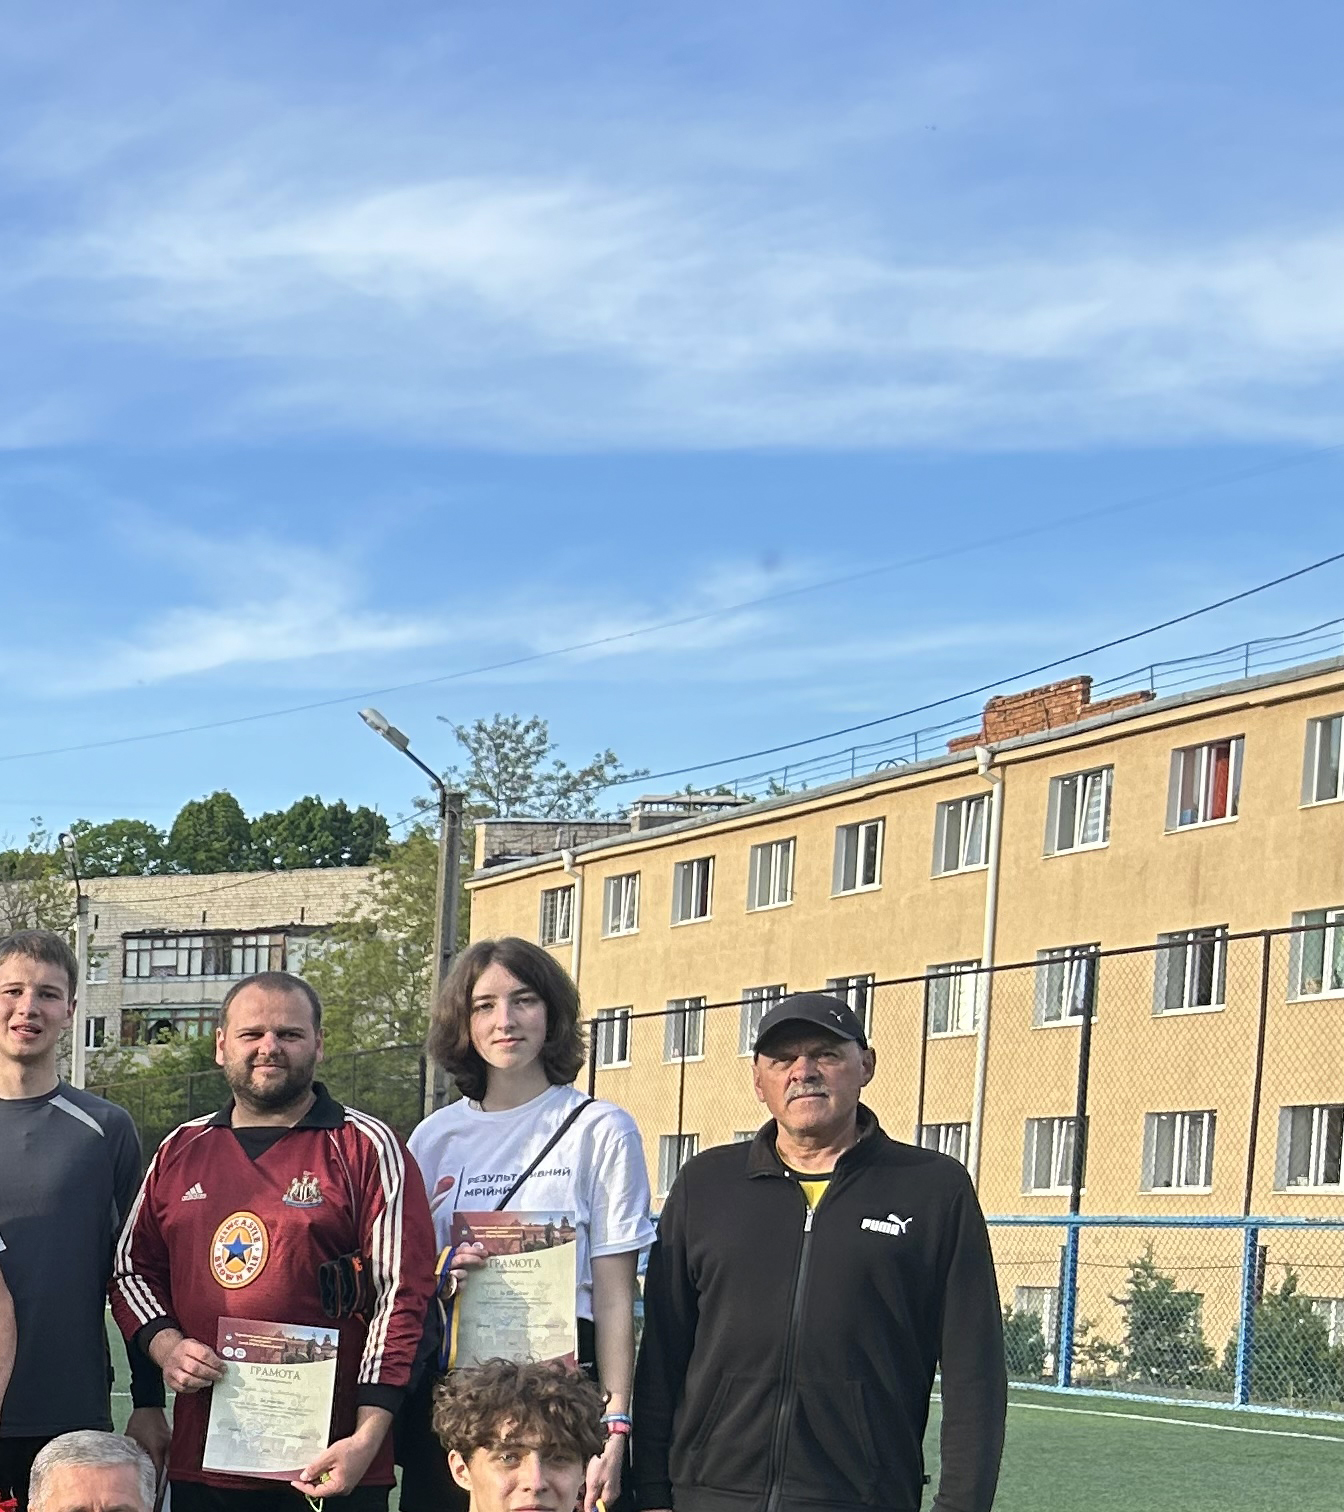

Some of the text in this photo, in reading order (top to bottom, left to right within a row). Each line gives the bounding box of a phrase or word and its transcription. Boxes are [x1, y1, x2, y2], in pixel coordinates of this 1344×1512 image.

[218, 1219, 261, 1243] NEWCASTLE
[214, 1255, 244, 1281] BROWN
[489, 1259, 541, 1268] ГРАМОТА
[250, 1366, 301, 1380] ГРАМОТА
